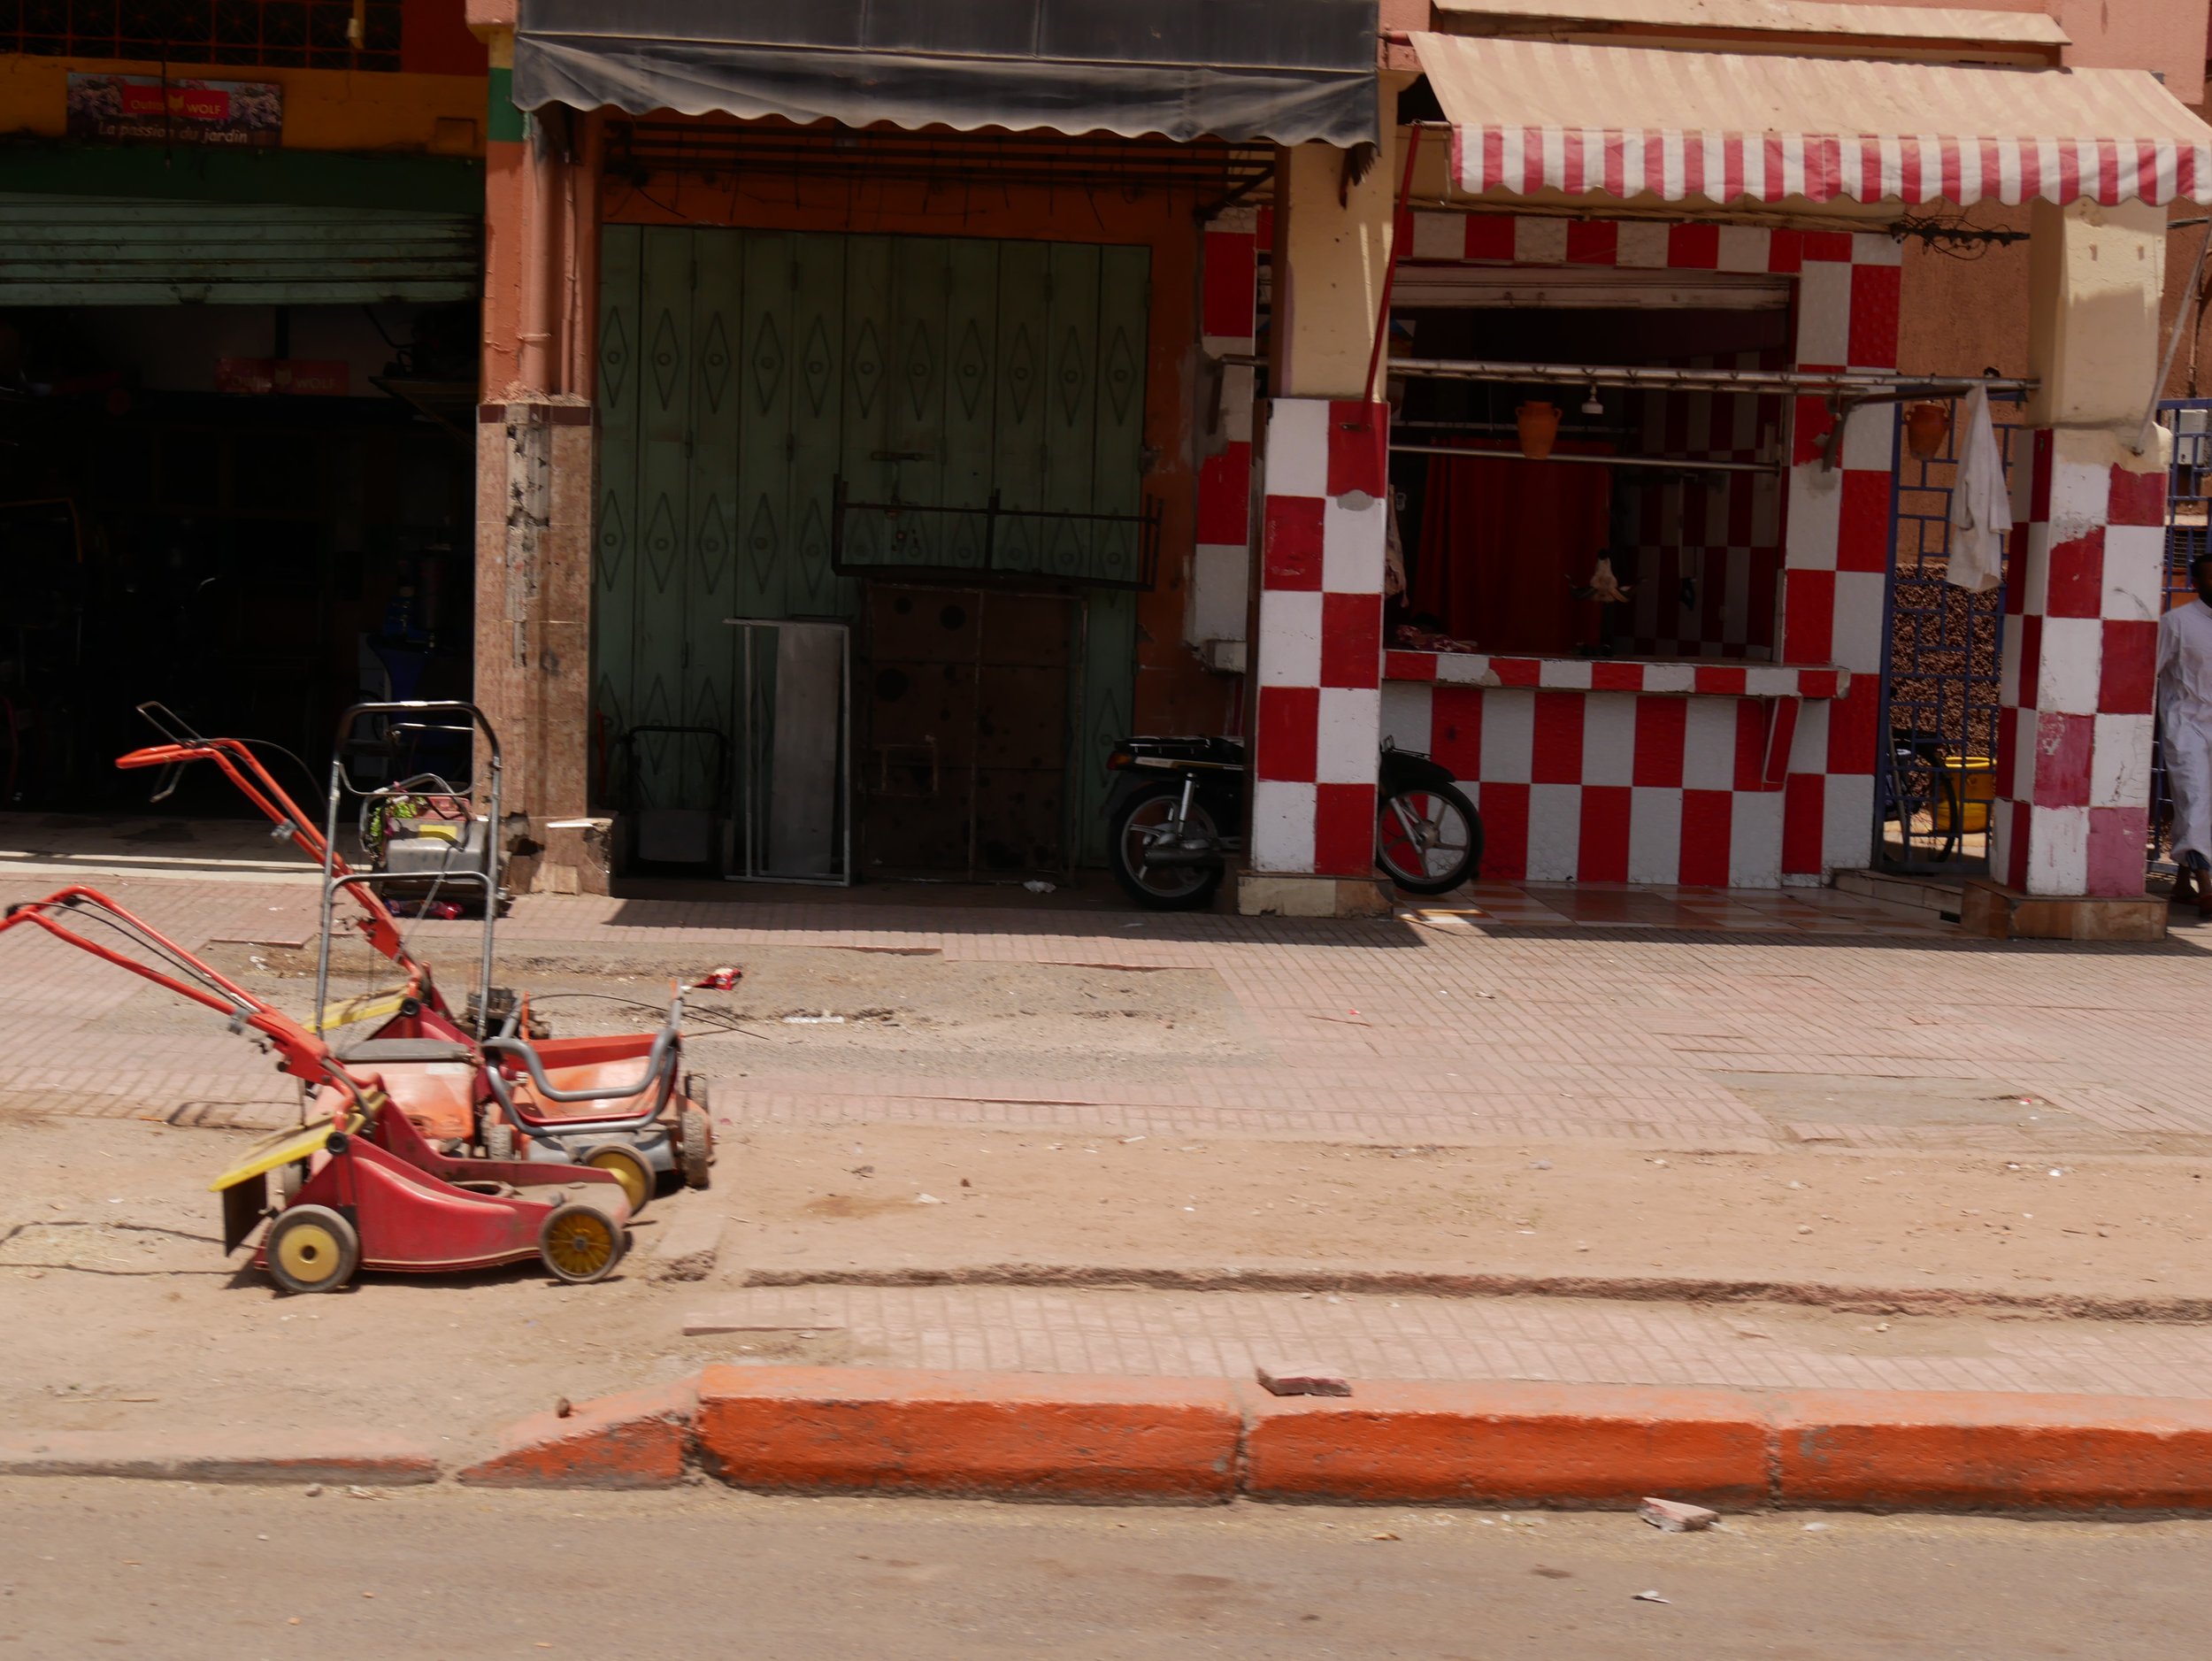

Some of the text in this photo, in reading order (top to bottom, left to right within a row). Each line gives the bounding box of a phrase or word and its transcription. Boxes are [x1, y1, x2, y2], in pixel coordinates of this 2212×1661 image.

[186, 103, 221, 115] WOLF
[98, 121, 116, 135] La
[180, 126, 200, 139] du
[203, 127, 248, 144] jardin
